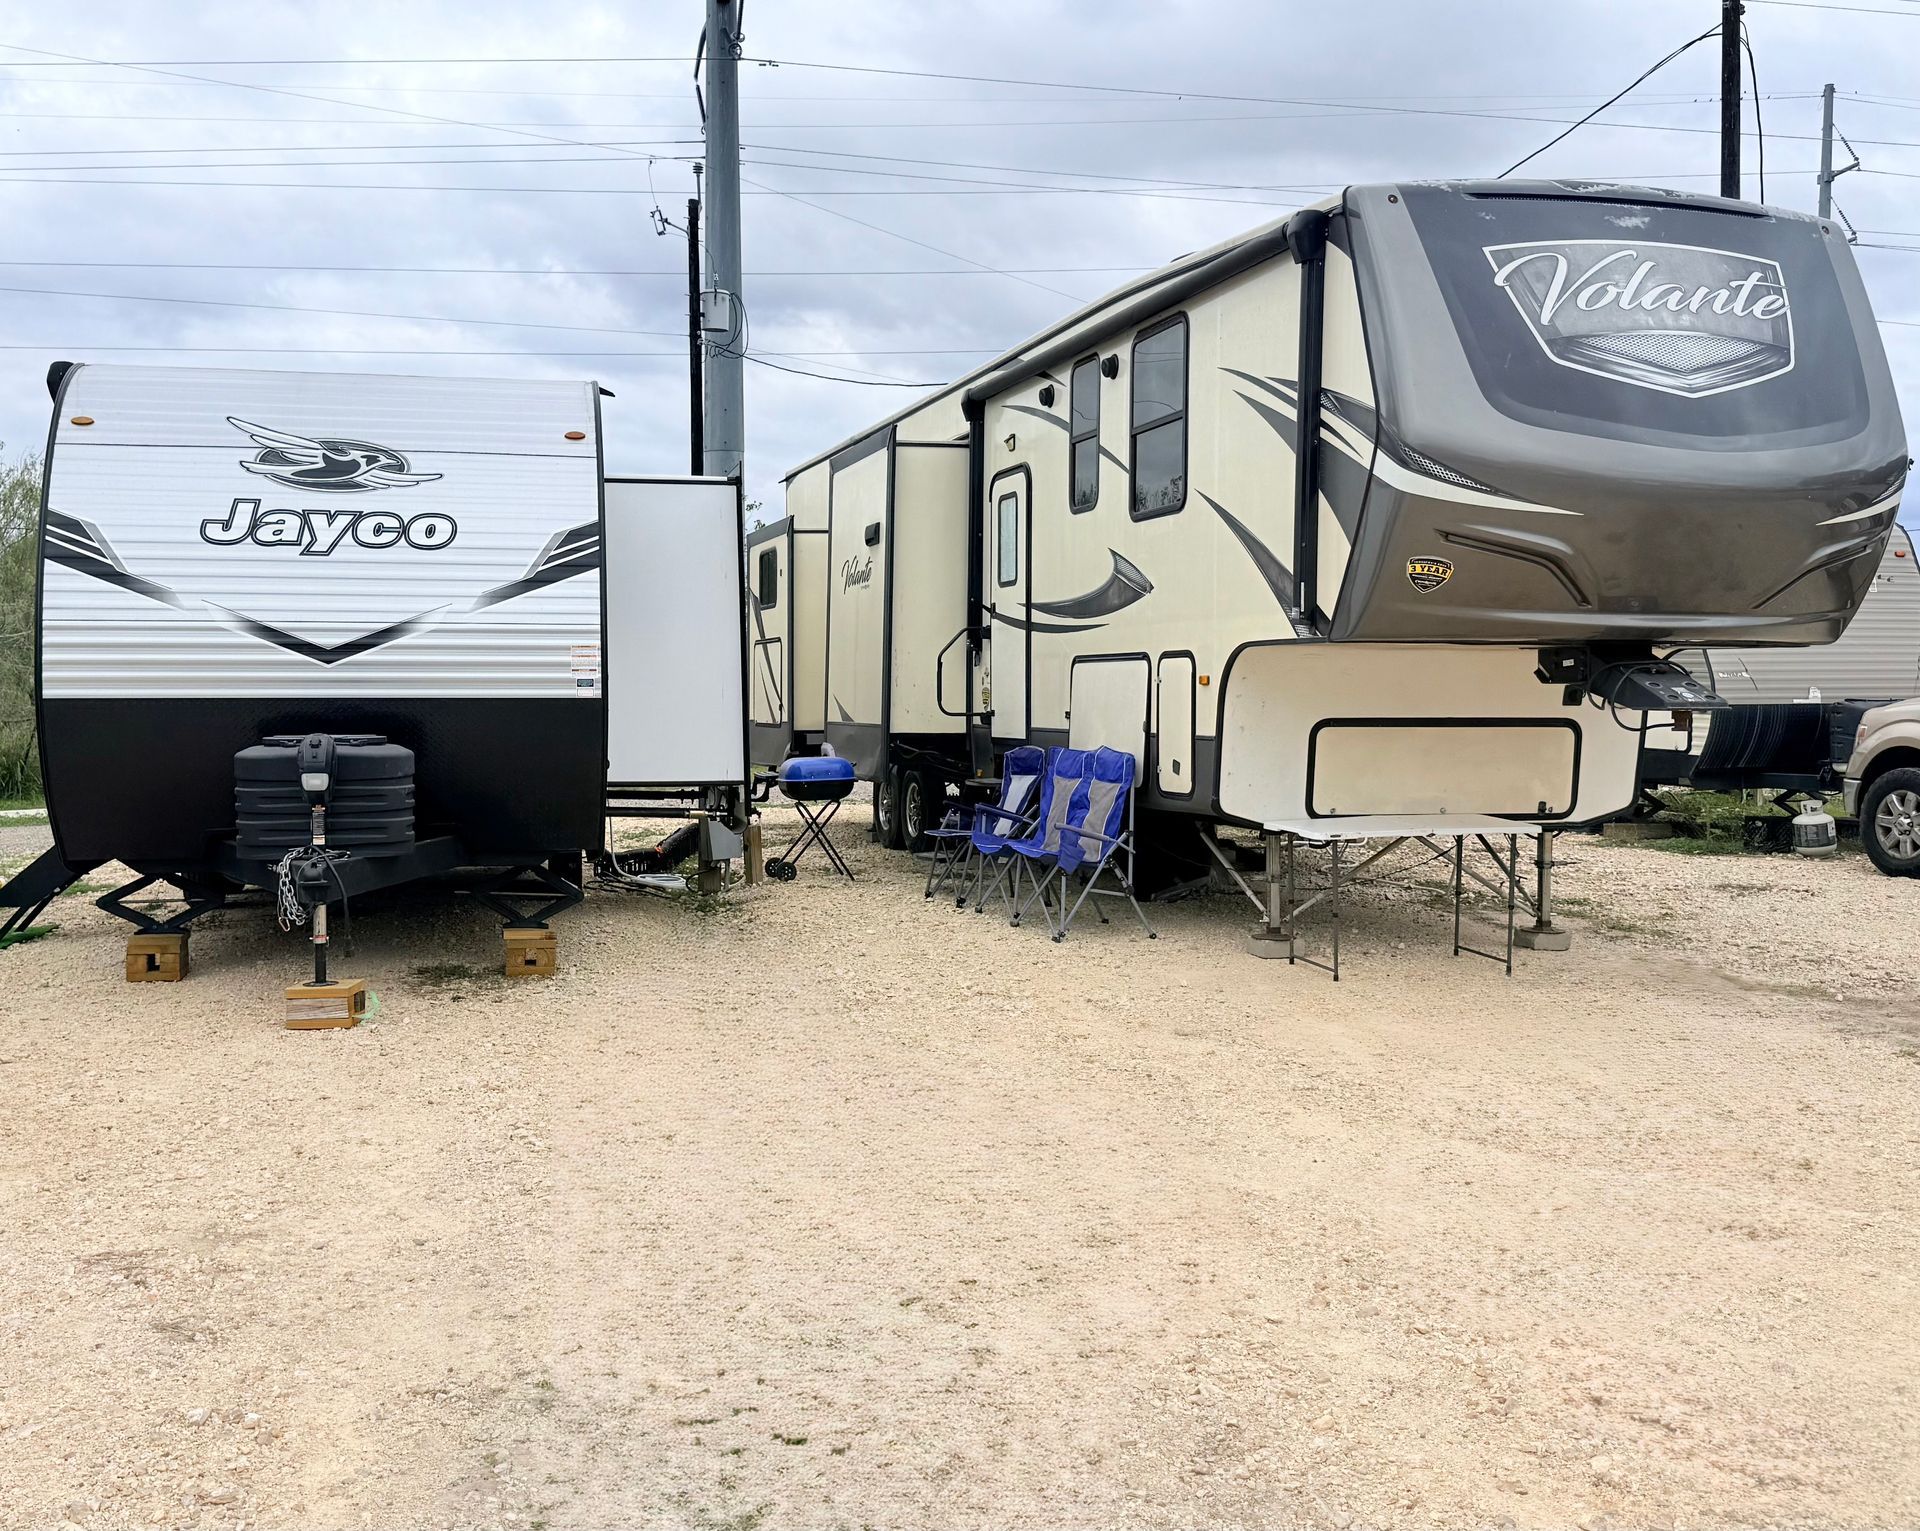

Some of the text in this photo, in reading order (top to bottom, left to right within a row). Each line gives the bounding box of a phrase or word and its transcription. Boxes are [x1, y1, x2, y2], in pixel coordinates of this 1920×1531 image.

[1494, 250, 1790, 326] Volante
[200, 498, 457, 556] Jayco
[841, 555, 873, 595] Volante
[1410, 565, 1417, 573] 3
[1420, 565, 1448, 577] YEAR
